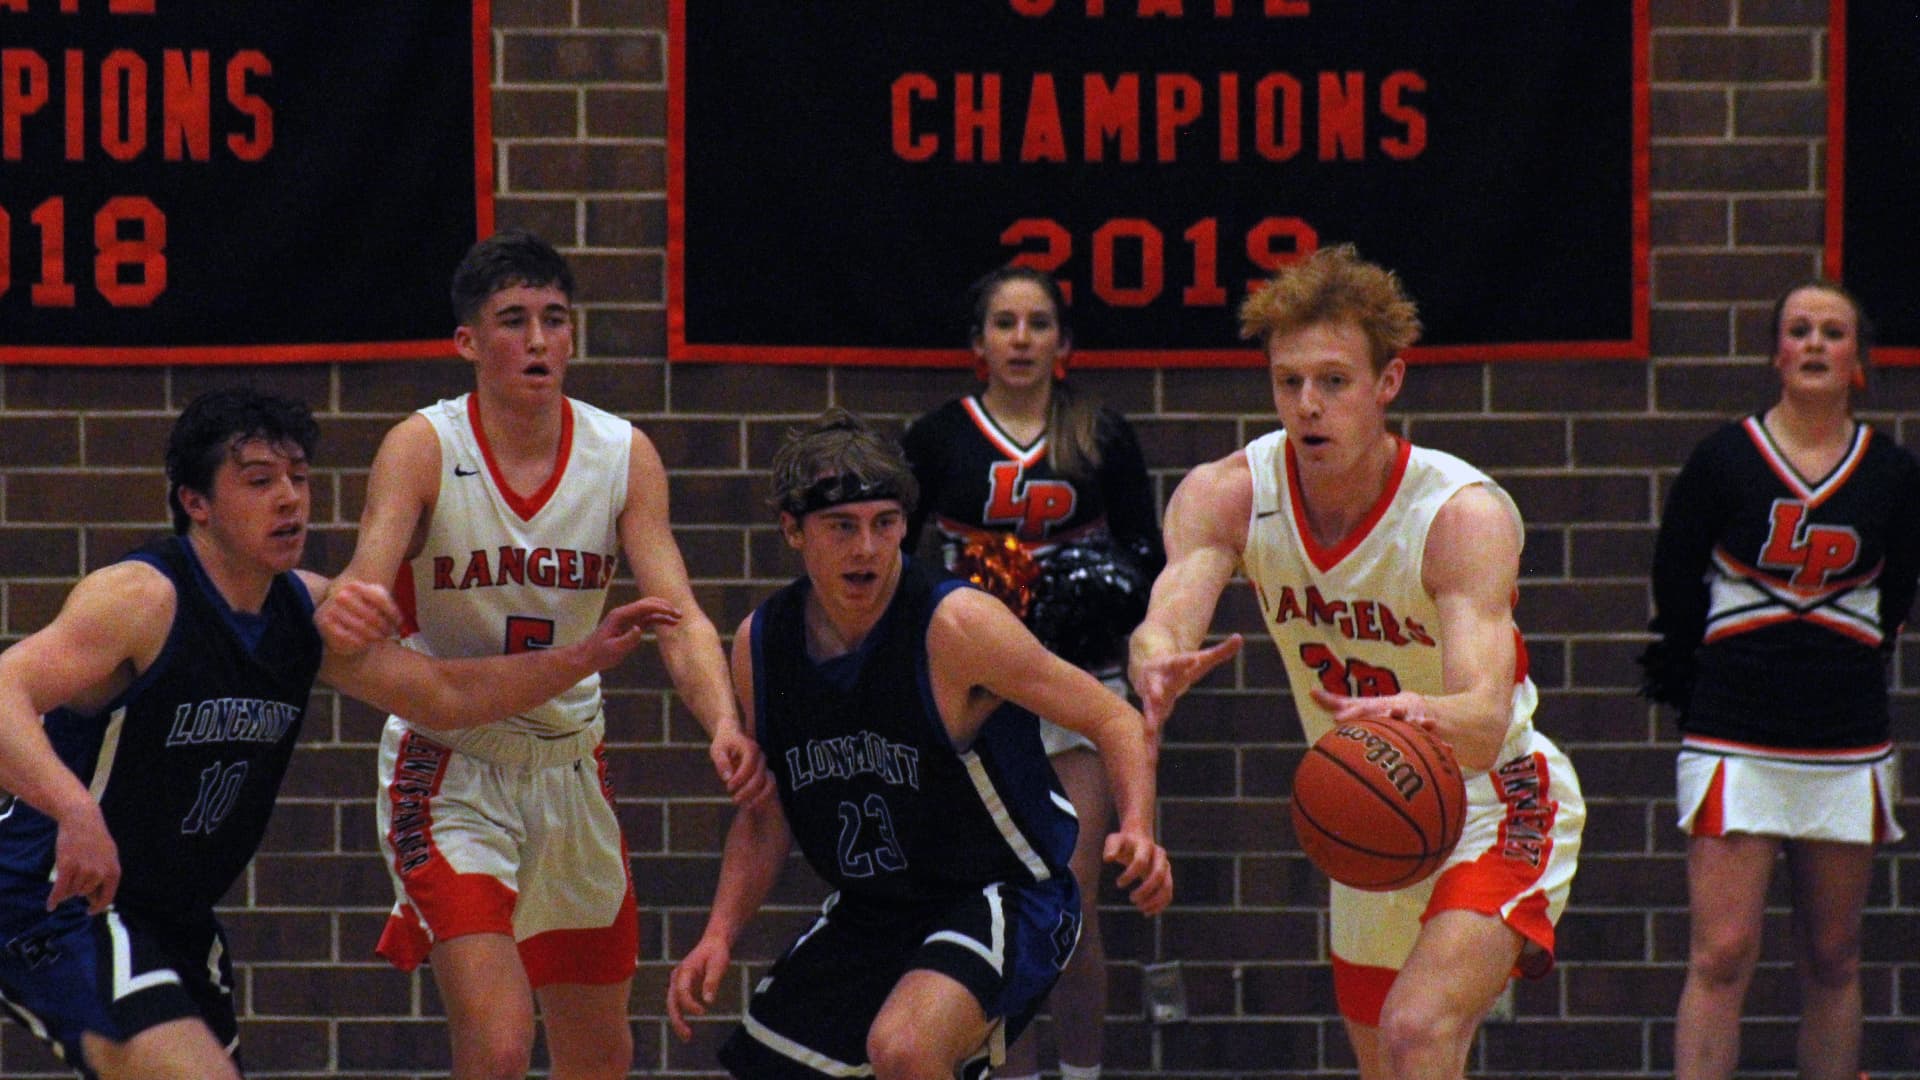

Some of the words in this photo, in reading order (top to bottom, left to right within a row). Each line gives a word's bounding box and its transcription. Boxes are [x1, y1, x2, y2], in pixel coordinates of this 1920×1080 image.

[891, 70, 1428, 163] CHAMPIONS
[0, 195, 167, 307] 18
[982, 460, 1077, 538] LP
[433, 545, 616, 590] RANGERS
[1756, 498, 1862, 590] LP
[1258, 578, 1437, 648] ANGERS
[165, 697, 302, 747] LONGMON
[785, 730, 920, 791] LONMONT
[181, 760, 249, 836] 10
[1336, 724, 1425, 803] Wilson
[837, 792, 908, 878] 23
